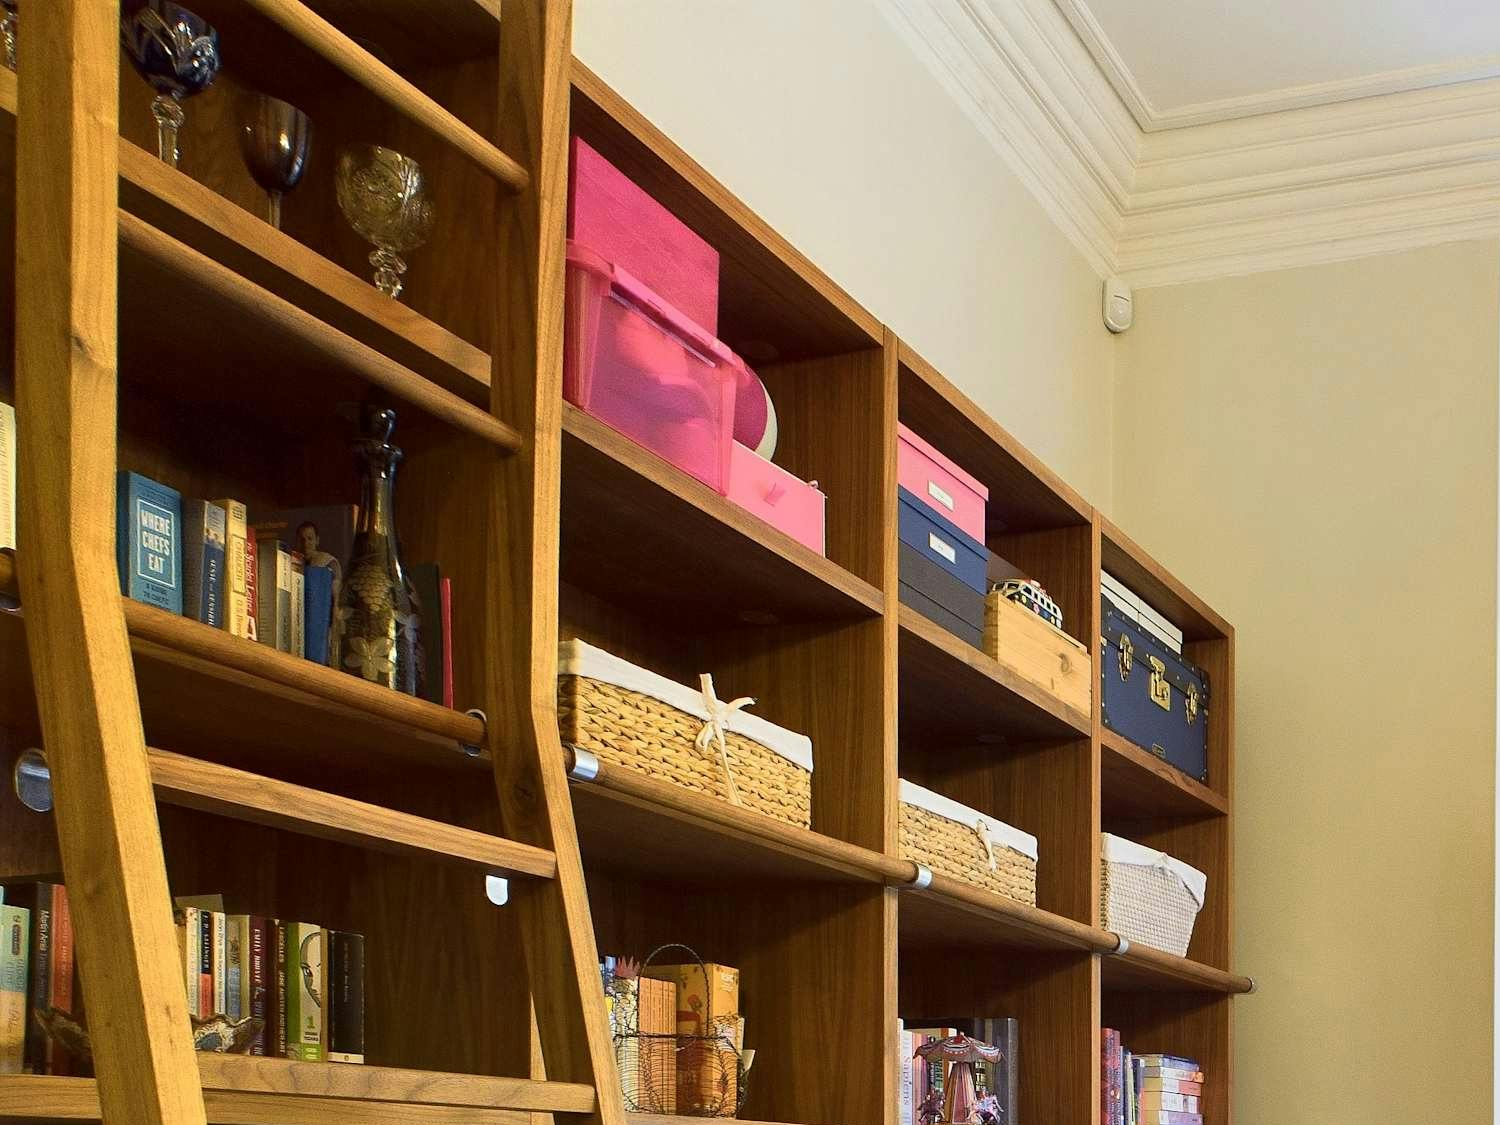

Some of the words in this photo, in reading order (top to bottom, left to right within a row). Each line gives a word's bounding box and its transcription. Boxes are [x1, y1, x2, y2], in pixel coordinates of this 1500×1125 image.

[140, 509, 171, 536] WHERE
[142, 532, 170, 556] CHEFS
[148, 553, 165, 574] EAT
[903, 1055, 912, 1106] Sapiens
